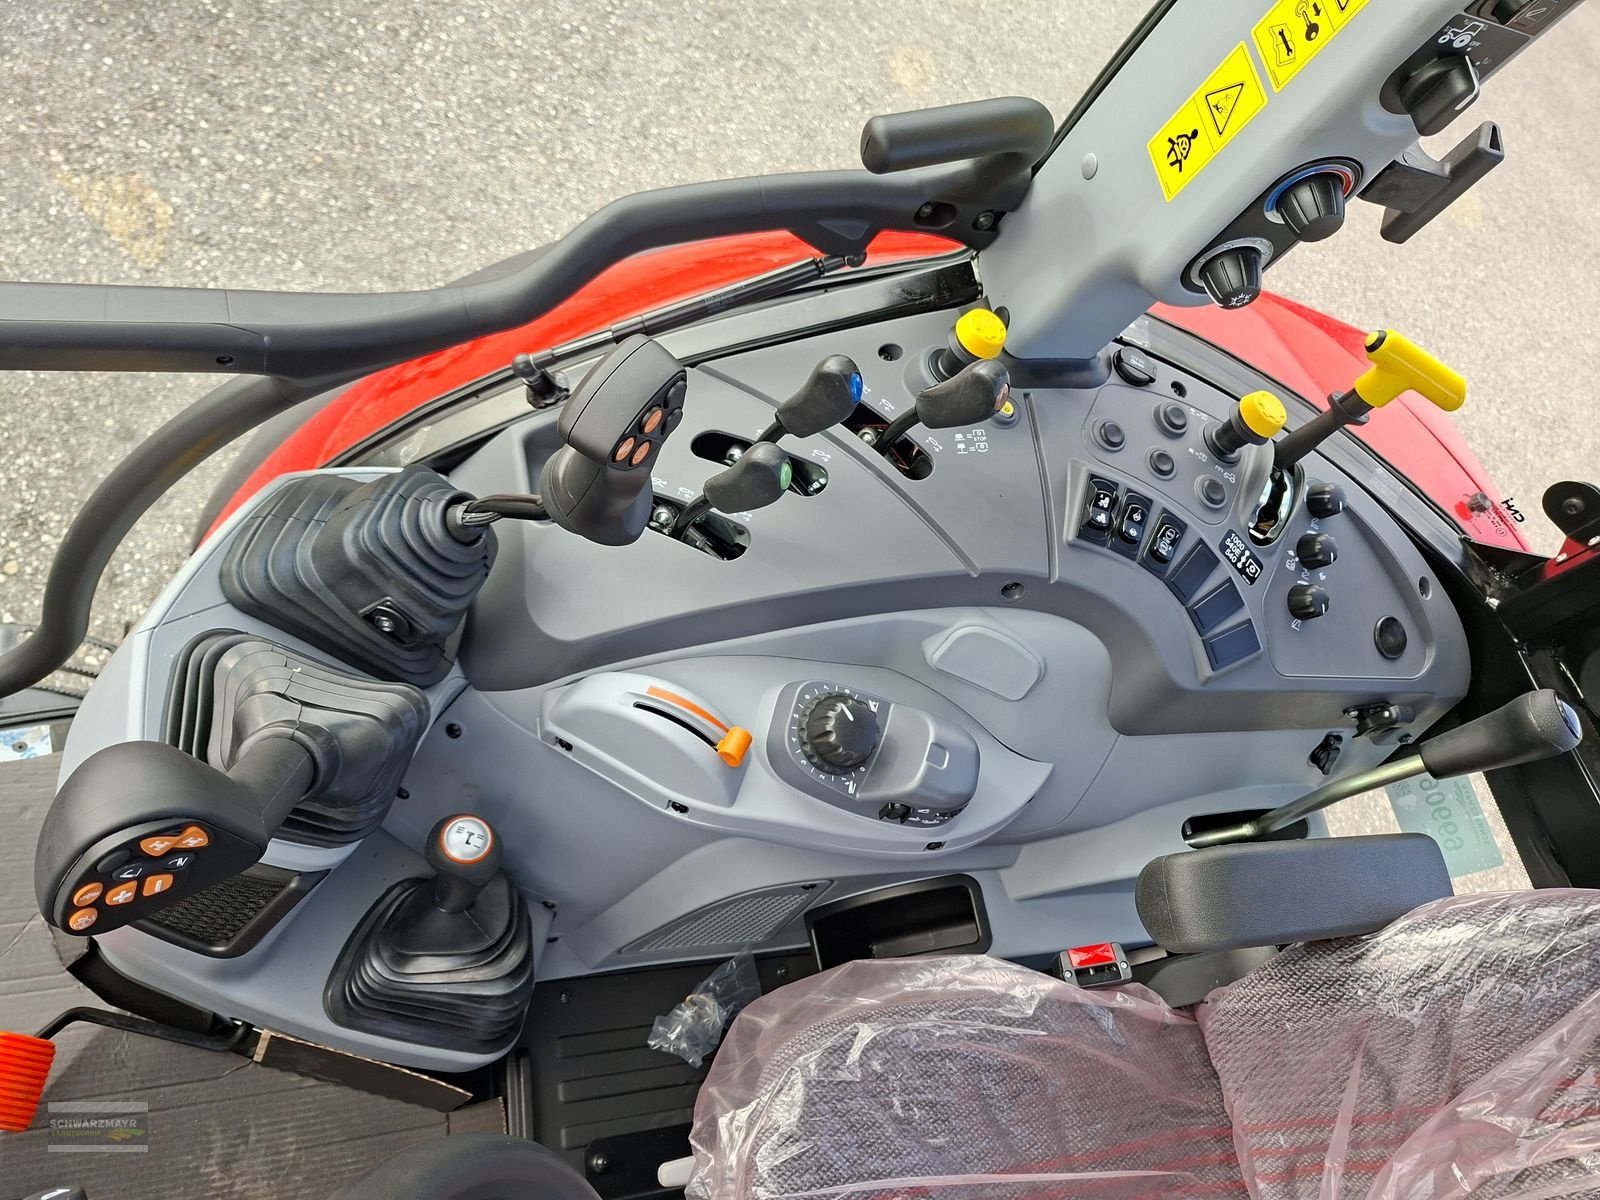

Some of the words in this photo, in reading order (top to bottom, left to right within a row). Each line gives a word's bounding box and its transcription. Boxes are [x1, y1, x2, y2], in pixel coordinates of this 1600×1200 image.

[1224, 537, 1242, 558] 540E
[1230, 533, 1245, 551] 1000
[1224, 548, 1238, 563] 540
